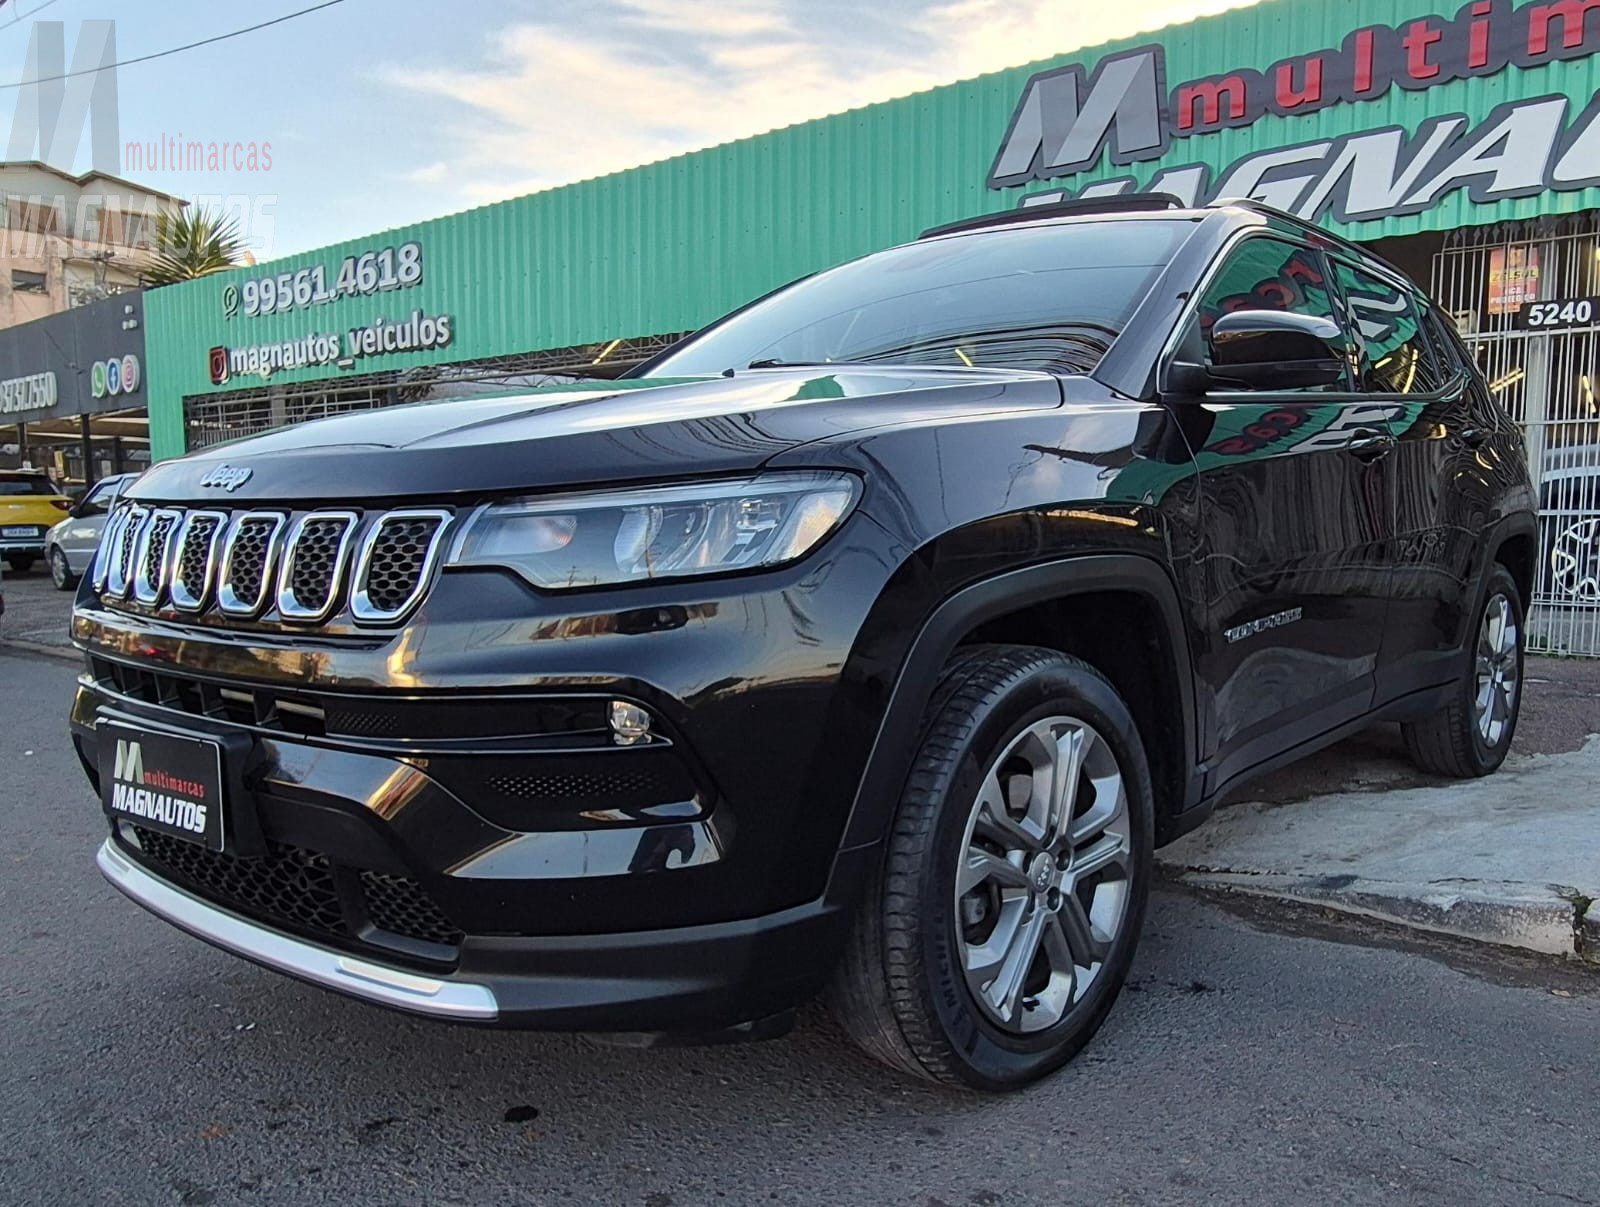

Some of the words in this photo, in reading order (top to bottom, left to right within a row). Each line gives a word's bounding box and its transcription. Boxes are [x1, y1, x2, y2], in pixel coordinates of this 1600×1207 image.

[994, 52, 1161, 178] M
[1023, 98, 1600, 221] GNA
[242, 243, 422, 315] 99561.4618
[230, 310, 450, 379] magnautos_veiculos
[1528, 301, 1592, 326] 5240
[200, 463, 252, 491] Jeep
[113, 738, 144, 784] M
[143, 770, 205, 798] multimarcas
[111, 783, 207, 834] MAGNAUTOS
